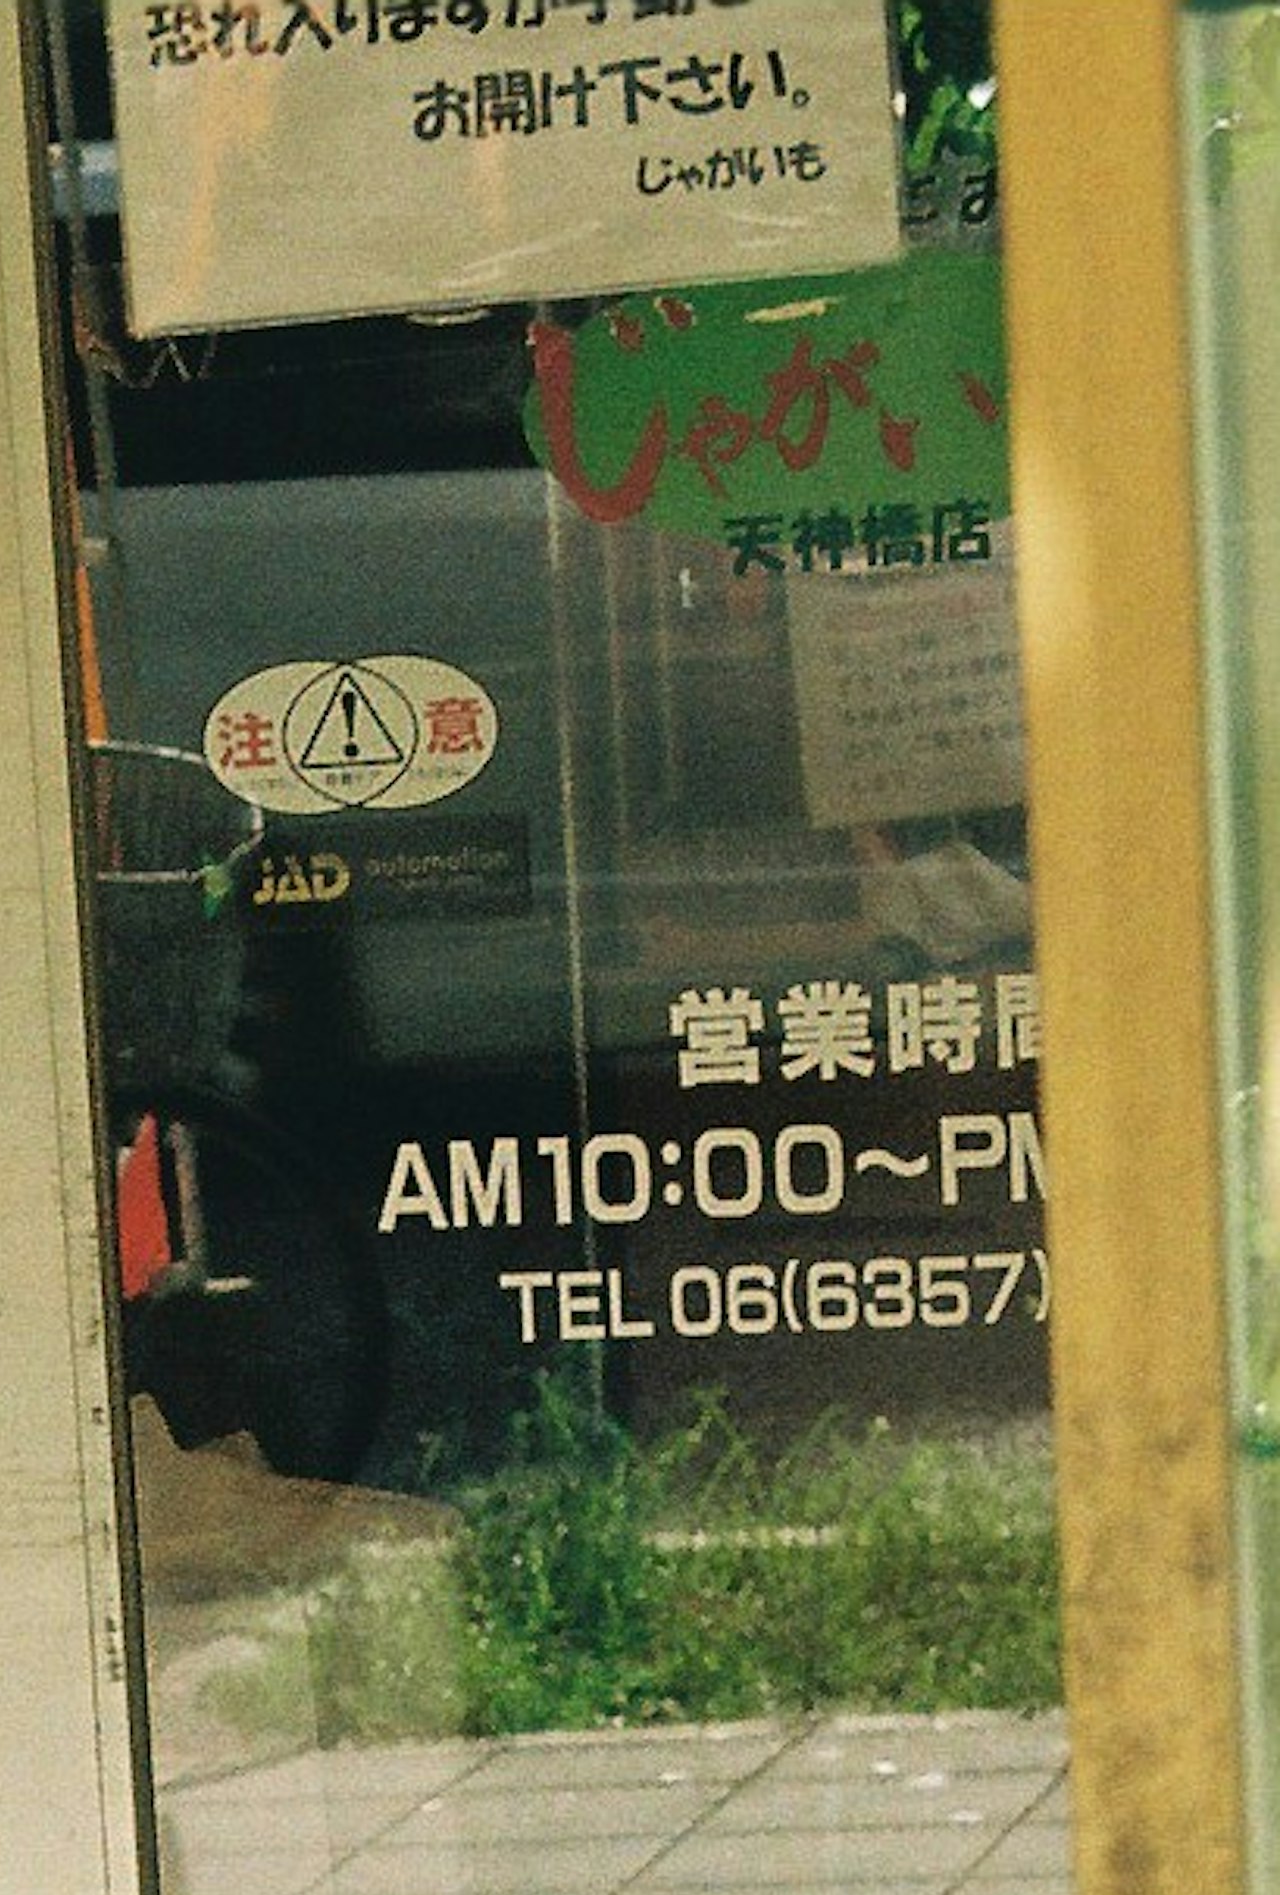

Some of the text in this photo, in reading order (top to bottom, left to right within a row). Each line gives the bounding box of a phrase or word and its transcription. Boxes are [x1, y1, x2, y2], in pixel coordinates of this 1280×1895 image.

[413, 50, 811, 141] お開け下さい。
[637, 144, 827, 196] じゃがいも
[723, 499, 991, 577] 天神橋店
[219, 697, 484, 769] 注 意
[253, 853, 351, 905] JAD
[500, 1269, 655, 1343] TEL
